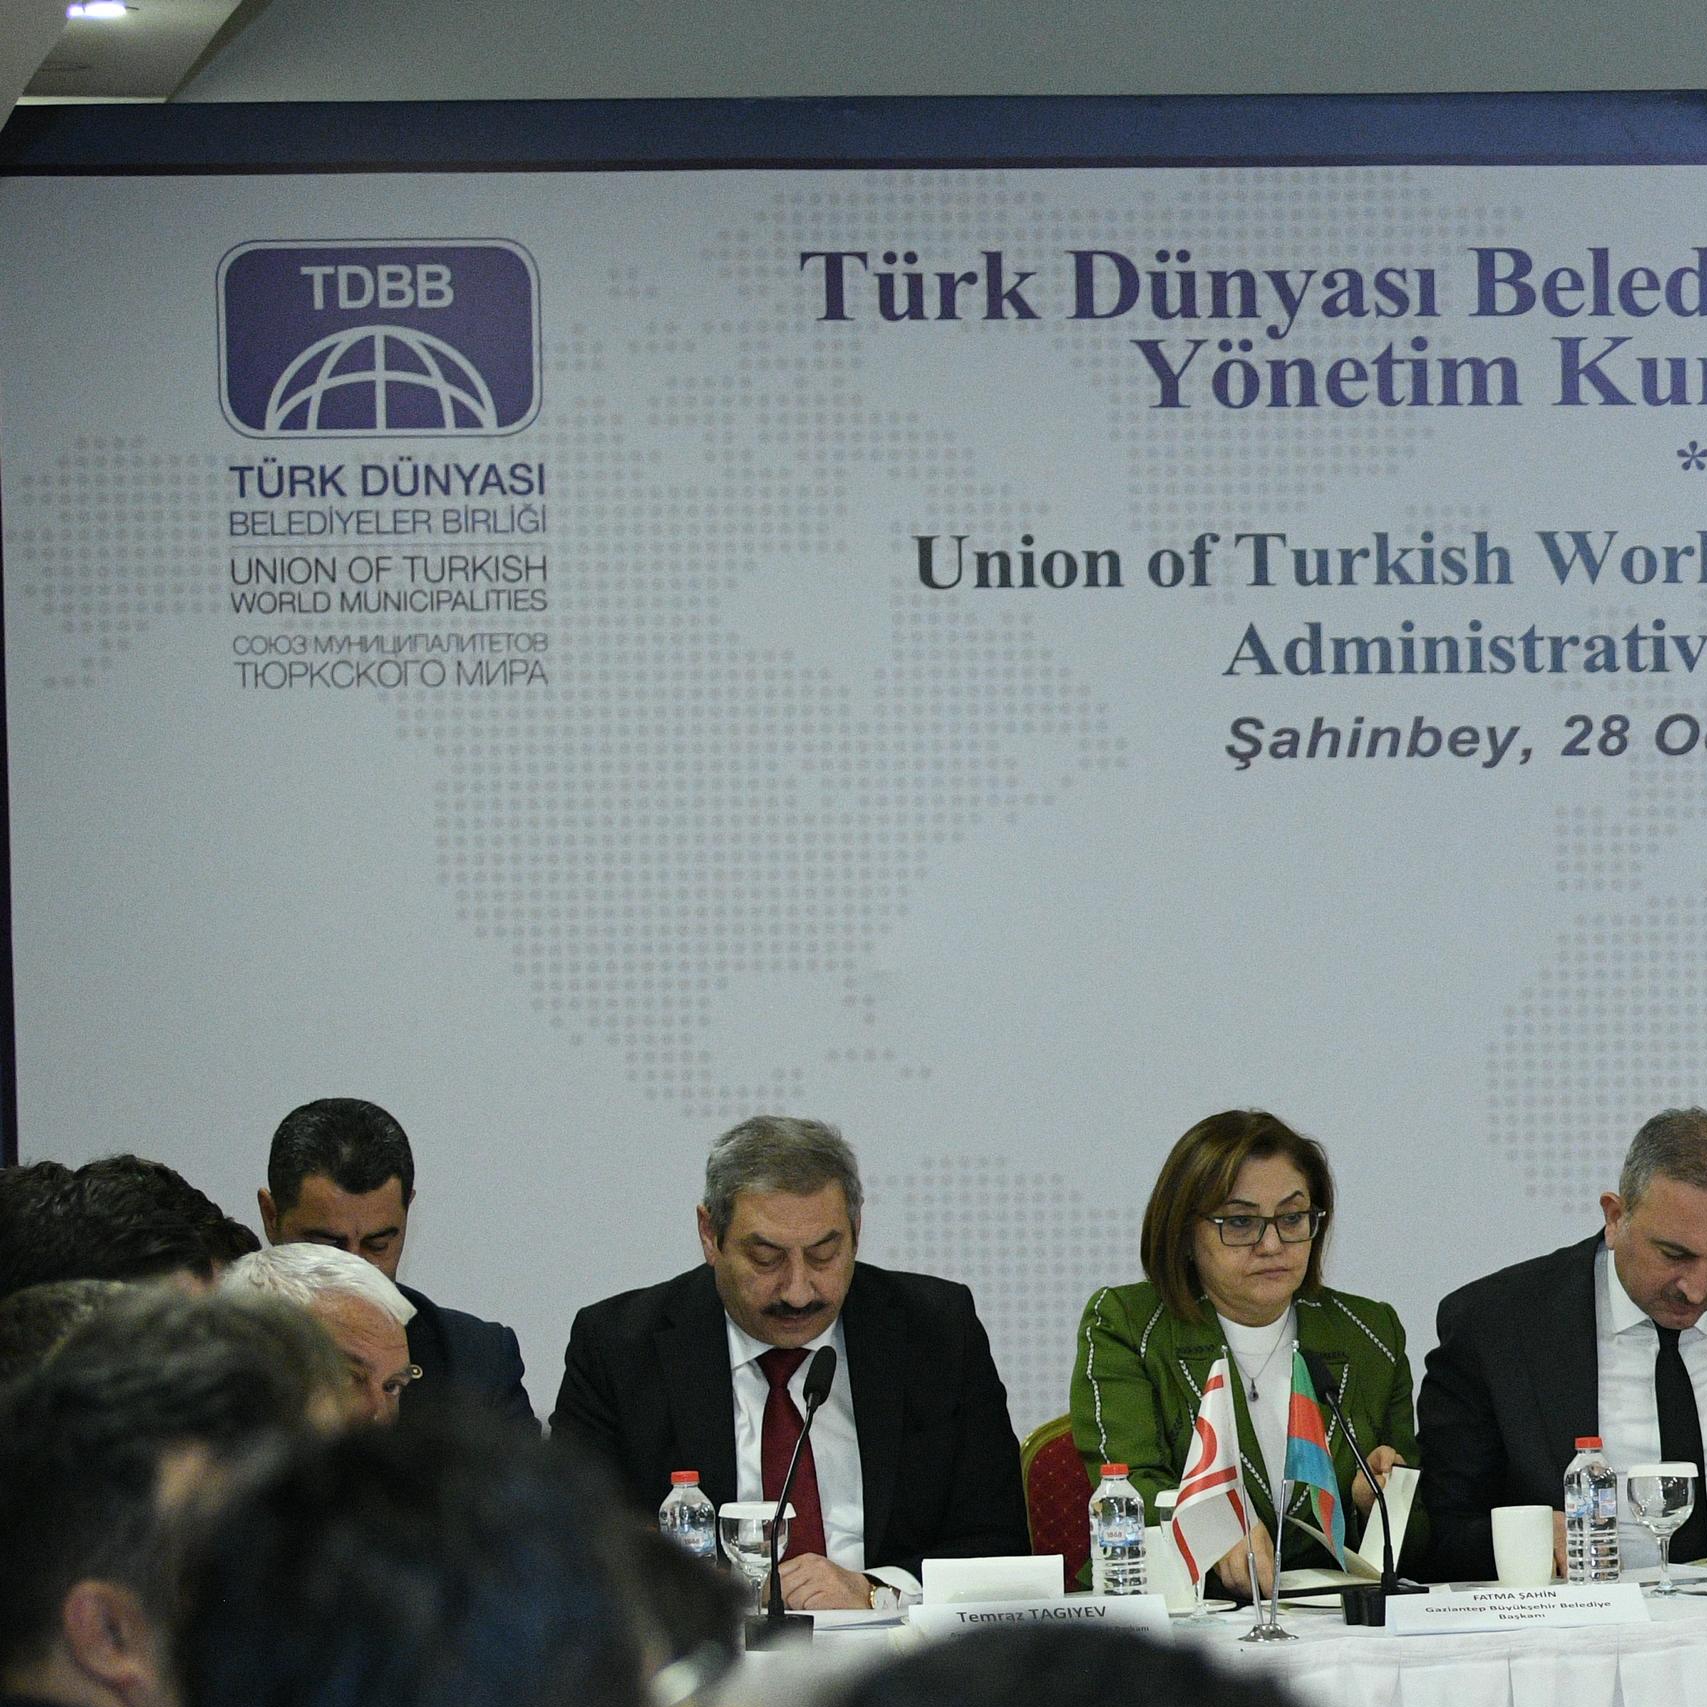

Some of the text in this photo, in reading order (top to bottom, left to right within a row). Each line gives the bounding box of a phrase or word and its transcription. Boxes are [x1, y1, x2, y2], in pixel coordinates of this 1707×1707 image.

[300, 264, 454, 310] TDBB
[800, 250, 1040, 322] Türk
[1066, 248, 1440, 339] Dünyası
[1130, 338, 1521, 410] Yönetim
[229, 456, 545, 499] TÜRK DÜNYASI
[229, 503, 546, 537] BELEDİYELER BİRLİĞİ
[231, 554, 547, 585] UNION OF TURKISH
[914, 533, 1125, 590] Union
[1148, 532, 1220, 588] of
[1235, 530, 1514, 587] Turkish
[231, 589, 548, 614] WORLD MUNICIPALITIES
[233, 632, 548, 657] СОЮЗ МУНИЦИПАЛИТЕТОВ
[234, 658, 549, 690] ТЮРКСКОГО МИРА
[1225, 716, 1533, 770] Şahinbey,
[1561, 714, 1630, 757] 28
[1425, 1601, 1612, 1613] Gaziantep Büyükşehir Belediye
[1473, 1590, 1557, 1602] FATMA ŞAHİN
[956, 1606, 1107, 1624] Temraz TAGIYEV
